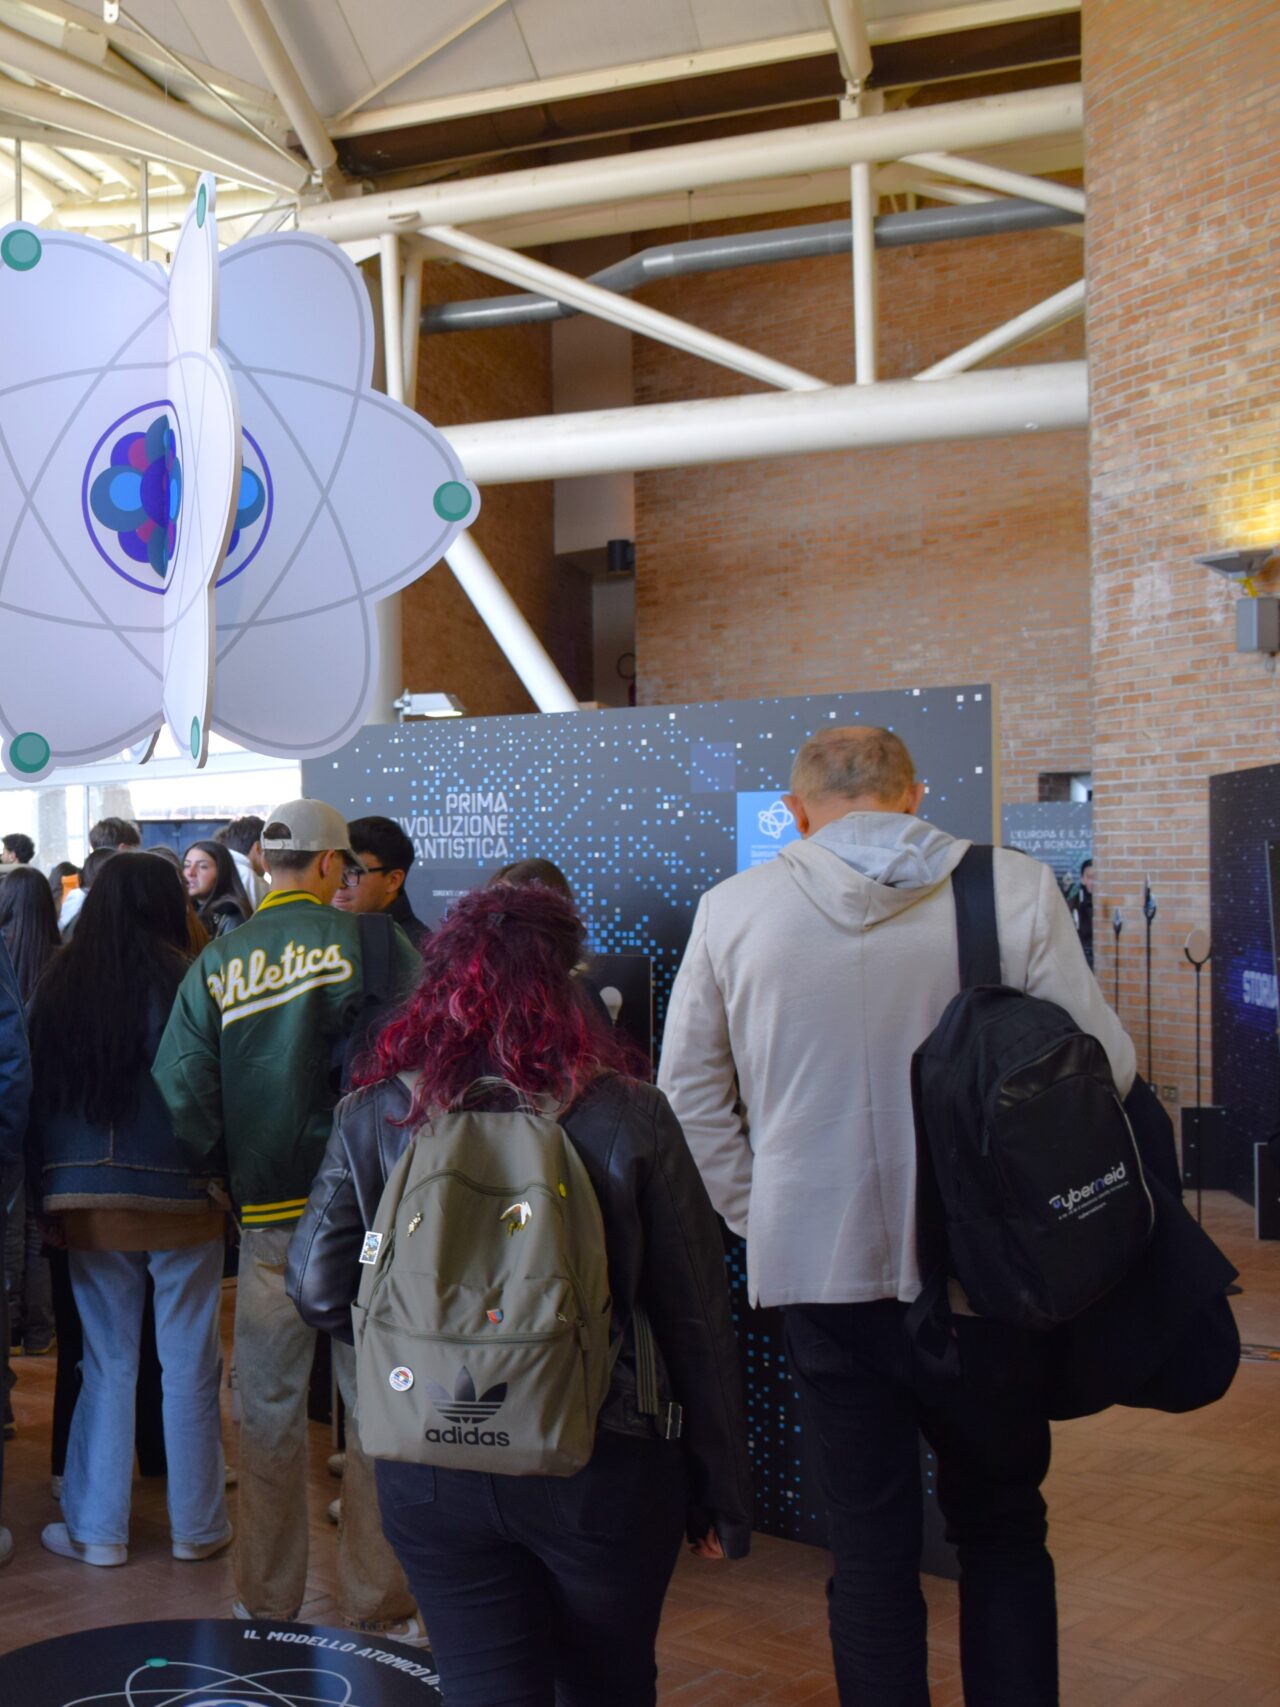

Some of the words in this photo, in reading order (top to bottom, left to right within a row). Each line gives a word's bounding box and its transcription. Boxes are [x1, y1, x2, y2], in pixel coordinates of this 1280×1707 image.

[446, 792, 508, 814] PRIMA
[413, 837, 509, 859] ANTISTICA
[425, 1426, 510, 1447] adidas
[243, 1629, 261, 1640] IL
[266, 1631, 357, 1652] MODELLO
[354, 1647, 430, 1678] ATOMICO
